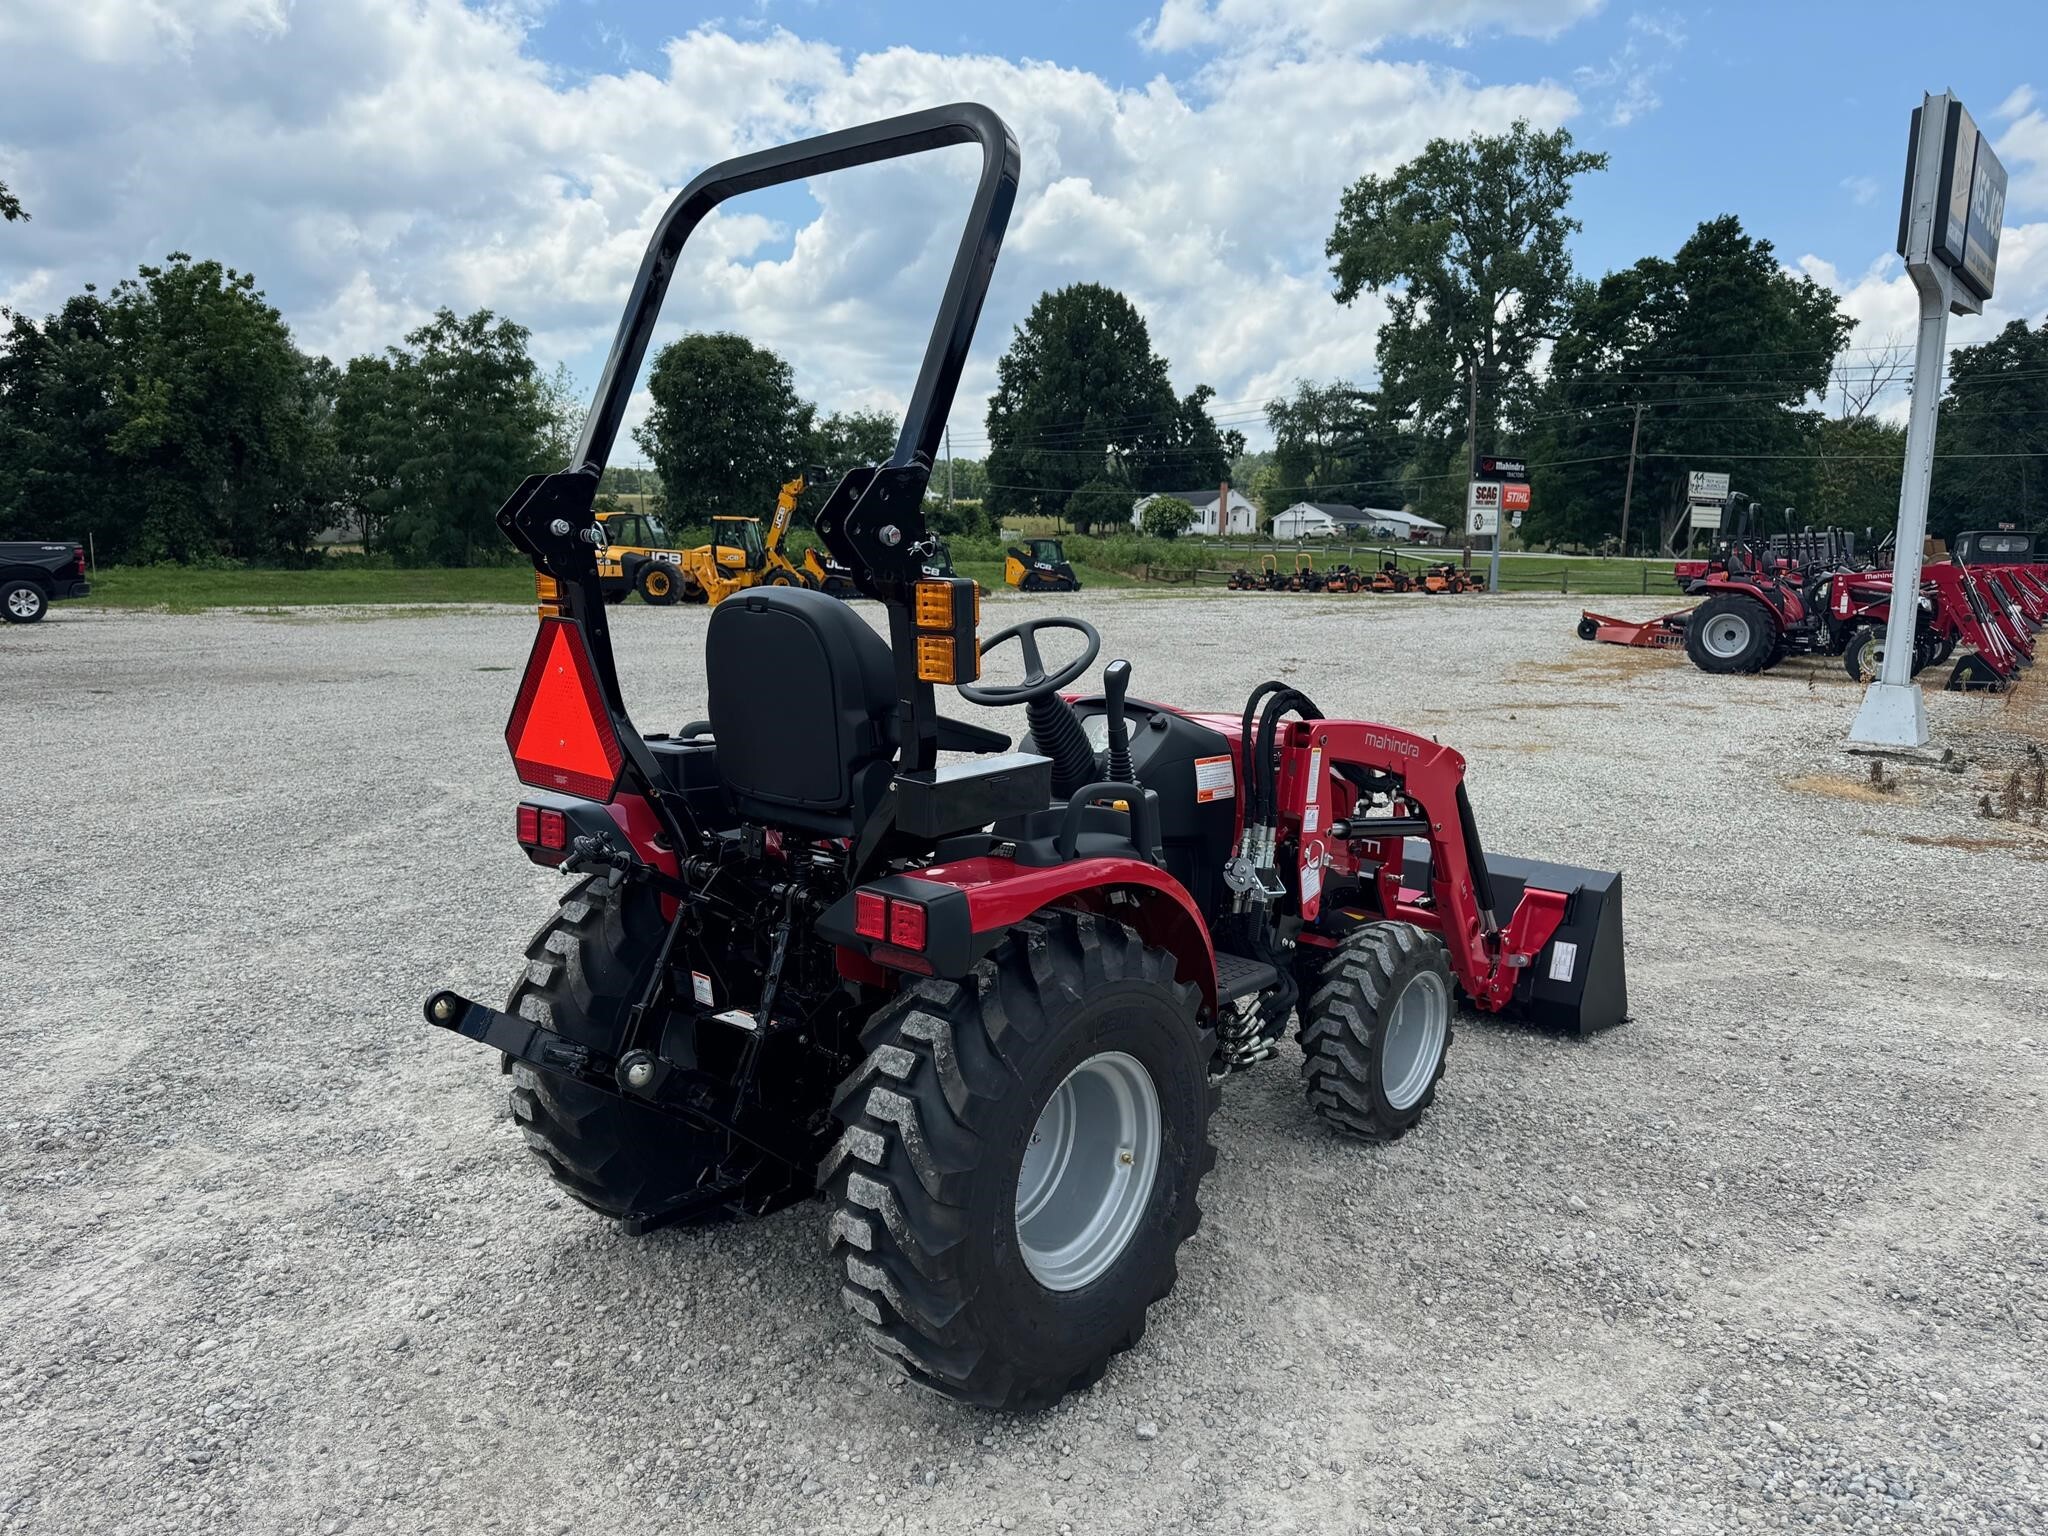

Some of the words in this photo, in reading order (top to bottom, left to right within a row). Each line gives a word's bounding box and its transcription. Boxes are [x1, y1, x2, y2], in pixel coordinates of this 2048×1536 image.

[1495, 461, 1525, 471] Mahindra
[1475, 486, 1498, 500] SCAG
[1506, 492, 1529, 503] STIHL
[776, 506, 786, 529] JCB
[921, 565, 939, 576] CB
[1034, 562, 1051, 570] JCB
[1364, 732, 1420, 758] mahindra
